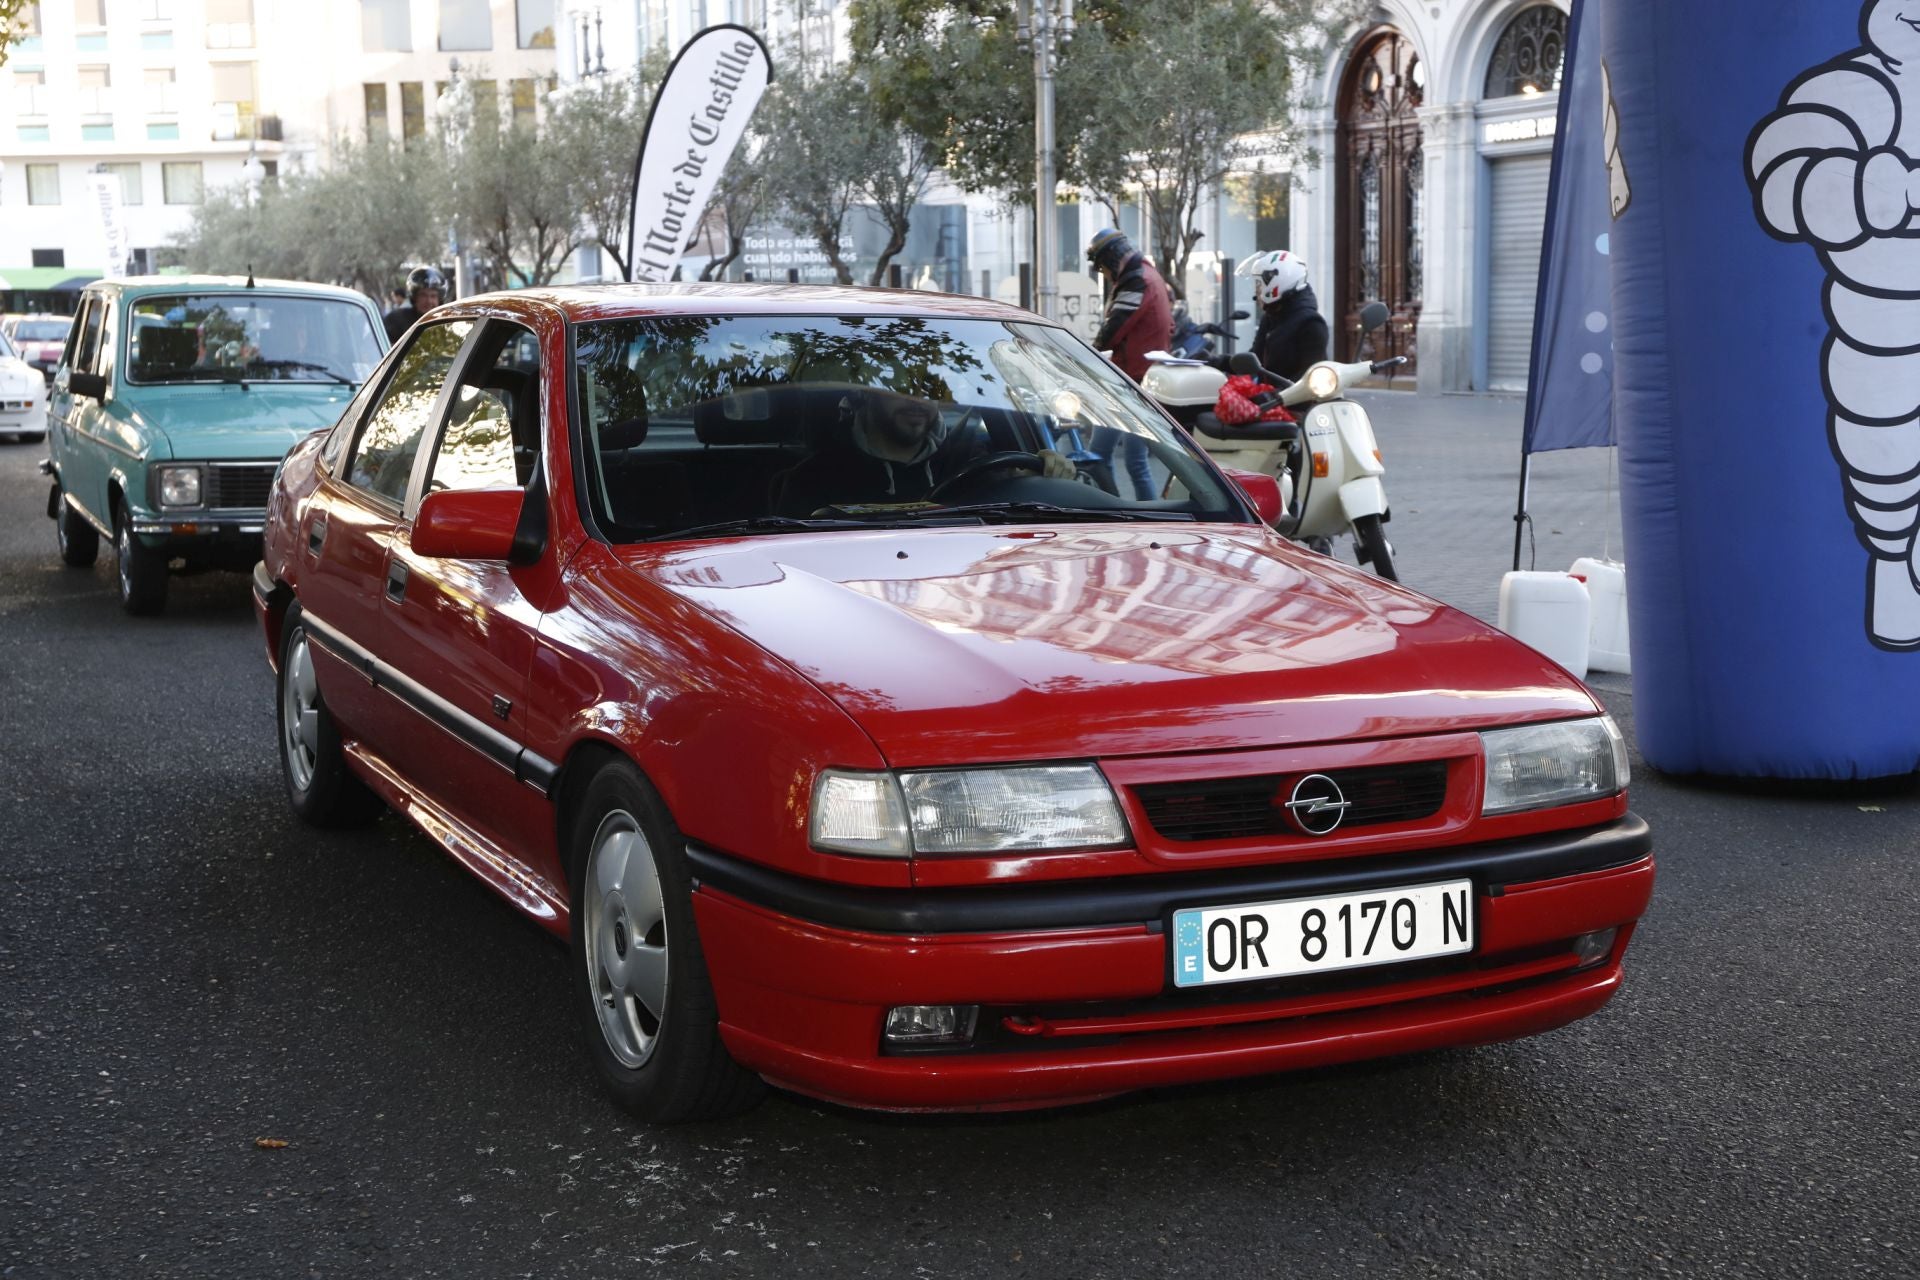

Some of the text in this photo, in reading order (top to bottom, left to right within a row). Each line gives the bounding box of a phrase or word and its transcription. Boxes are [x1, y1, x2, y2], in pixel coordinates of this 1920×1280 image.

[688, 40, 757, 146] Castilla
[672, 148, 708, 178] de
[643, 181, 695, 256] Norte
[744, 236, 775, 248] Todo
[777, 240, 792, 248] es
[743, 252, 791, 264] cuando
[1207, 889, 1468, 973] OR 8170 N
[1184, 955, 1197, 972] E
